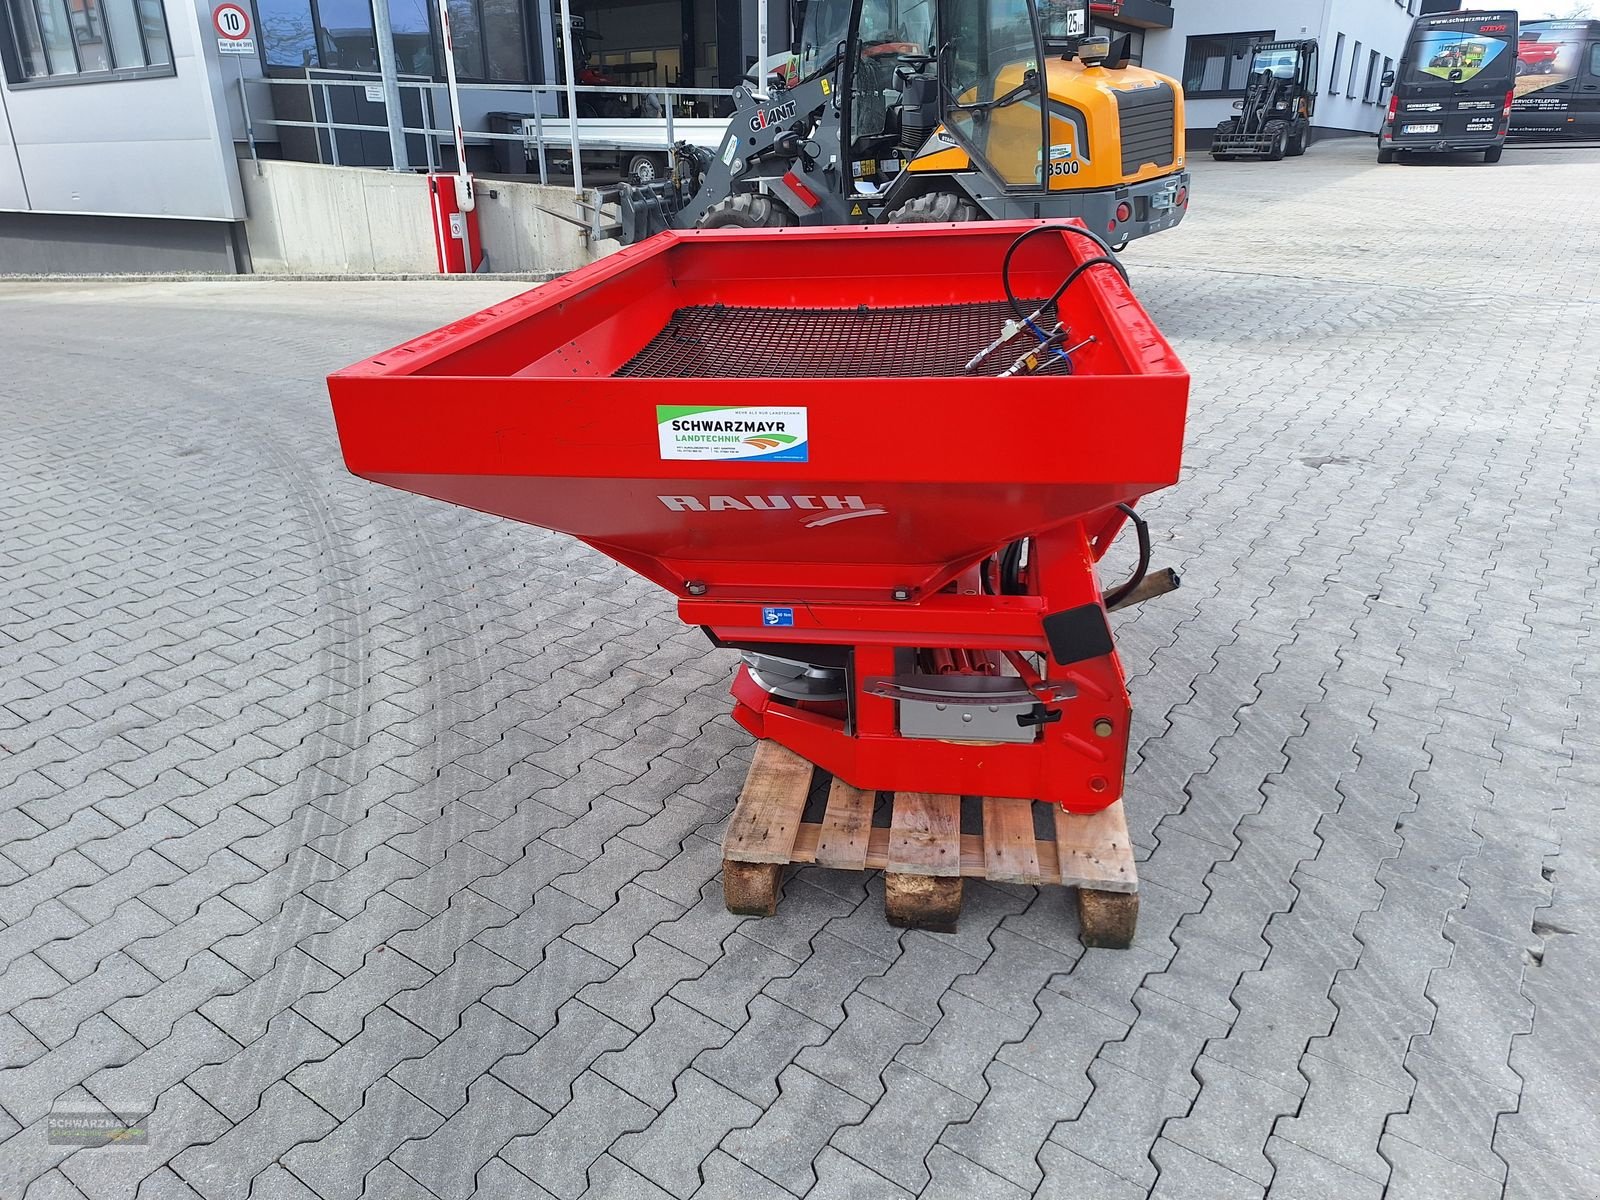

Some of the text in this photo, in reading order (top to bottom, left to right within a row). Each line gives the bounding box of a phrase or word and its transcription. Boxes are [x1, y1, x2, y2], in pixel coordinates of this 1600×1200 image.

[224, 13, 239, 30] 10
[1069, 13, 1078, 33] 25
[1430, 15, 1500, 25] www.schwarzmayr.at
[1482, 123, 1494, 131] 25
[672, 420, 785, 432] SCHWARZMAYR
[675, 434, 741, 443] LANDTECHNIK
[656, 495, 866, 512] RAUCH
